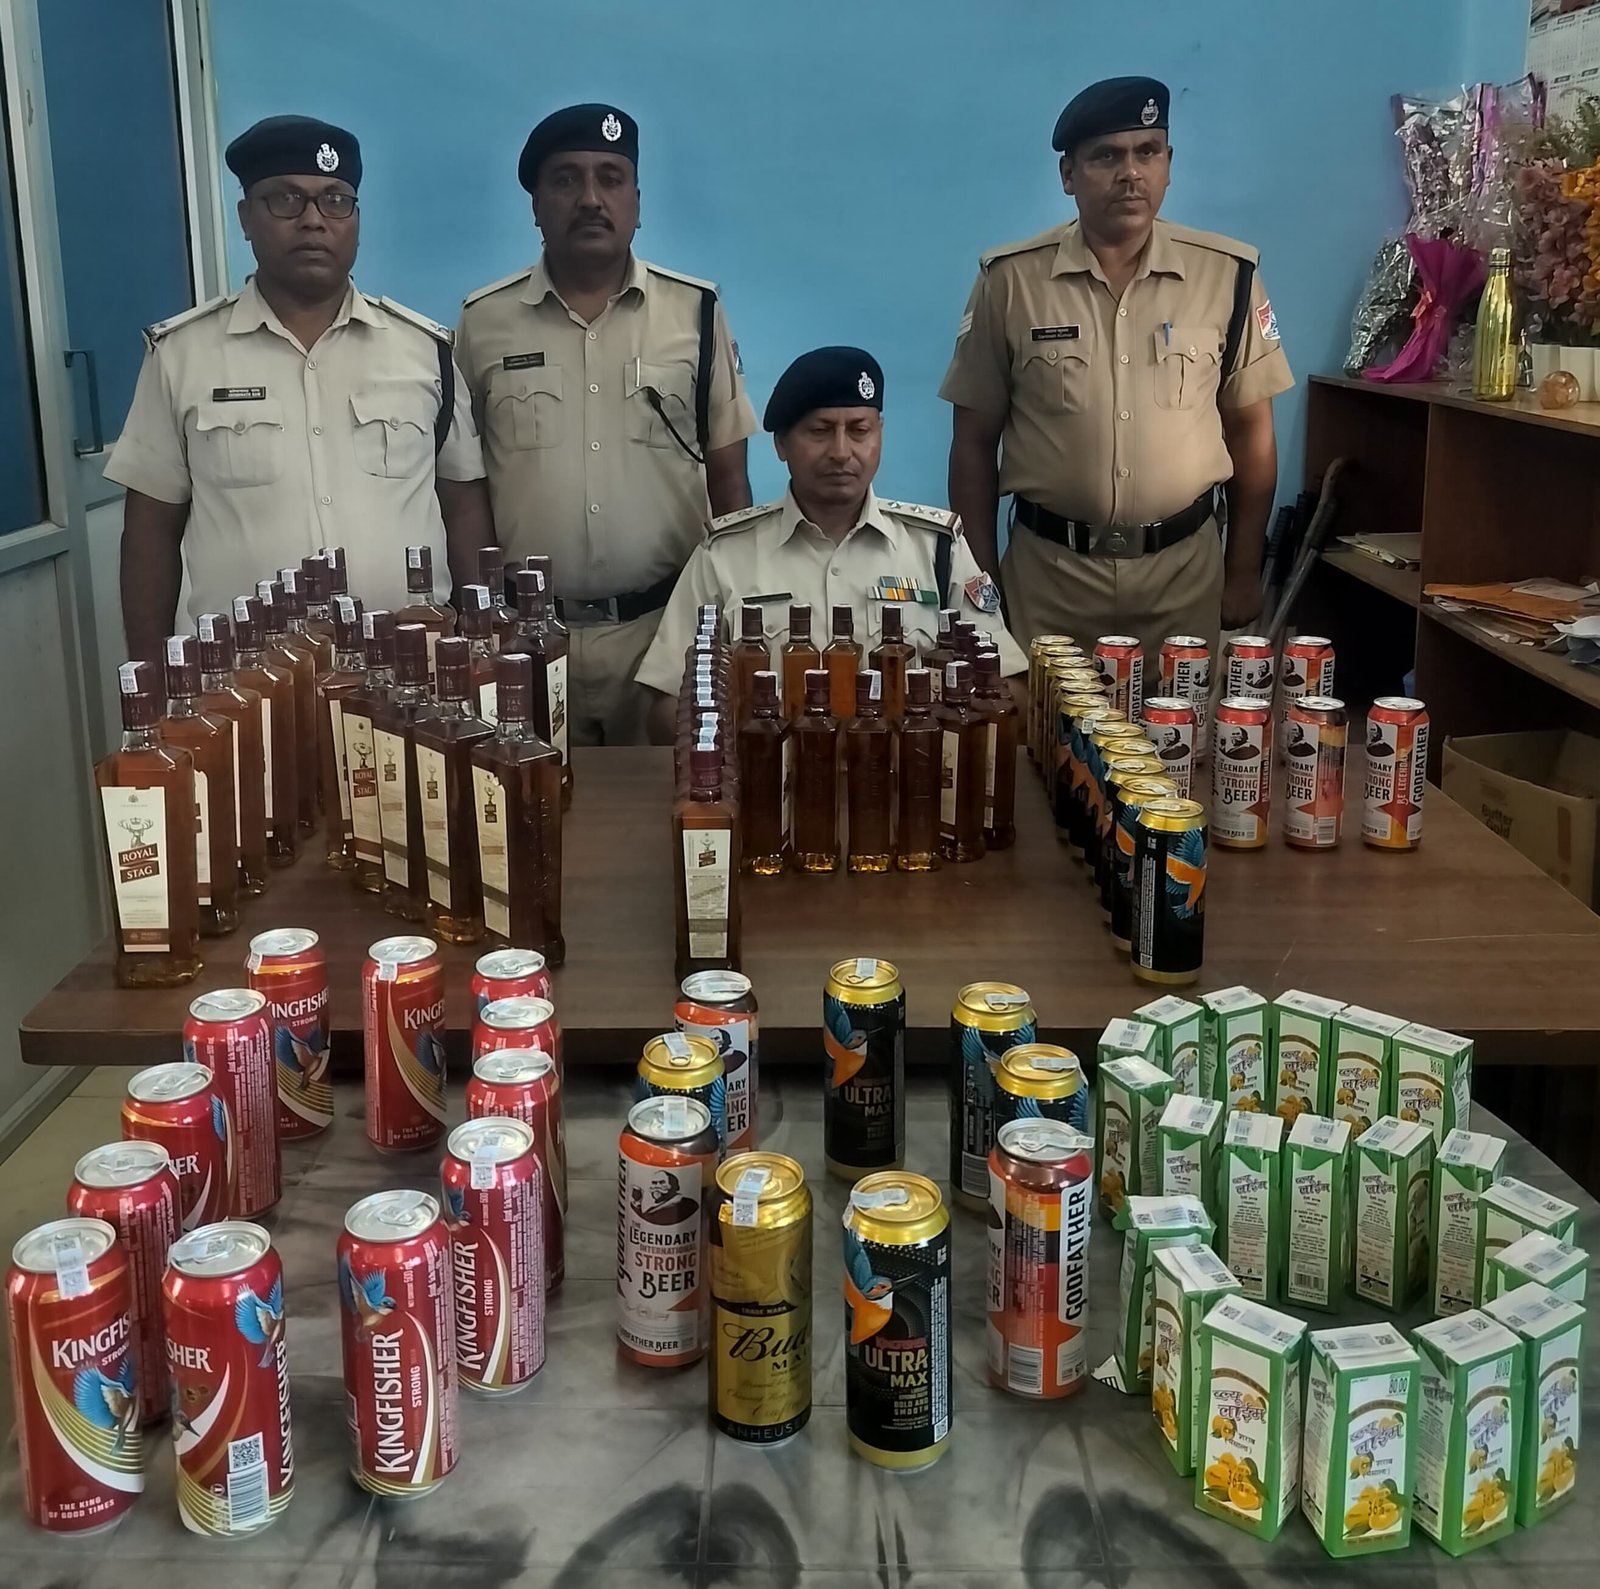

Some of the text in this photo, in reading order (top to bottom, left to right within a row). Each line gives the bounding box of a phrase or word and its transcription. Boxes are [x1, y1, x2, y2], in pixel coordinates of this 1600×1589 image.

[1229, 660, 1243, 698] ATHER
[1167, 764, 1189, 773] NDARY
[1218, 762, 1259, 774] LEGENDARY
[1414, 726, 1429, 803] GODFATHER
[355, 770, 373, 779] ROYAL
[1220, 777, 1258, 789] STRONG
[357, 787, 372, 795] STAG
[1222, 787, 1257, 805] BEER
[122, 847, 155, 863] ROYAL
[126, 865, 153, 880] STAG
[292, 1015, 318, 1028] STRONG
[728, 1078, 747, 1092] ARY
[845, 1085, 891, 1105] ULTRA
[864, 1104, 891, 1118] MAX
[728, 1113, 747, 1133] ER
[629, 1226, 697, 1246] LEGENDARY
[635, 1252, 697, 1272] STRONG
[1066, 1187, 1086, 1321] GODFATHER
[403, 1270, 414, 1283] 500
[638, 1270, 695, 1299] BEER
[454, 1239, 485, 1371] KINGFISHER
[484, 1278, 494, 1316] STRONG
[654, 1340, 679, 1353] BEER
[865, 1344, 929, 1373] ULTRA
[409, 1365, 423, 1408] STRONG
[890, 1370, 928, 1388] MAX
[372, 1327, 415, 1473] KINGFISHER
[727, 1422, 794, 1440] ANHEUS
[59, 1496, 102, 1511] THE KING
[61, 1509, 85, 1519] GOOD
[88, 1498, 115, 1515] TIMES
